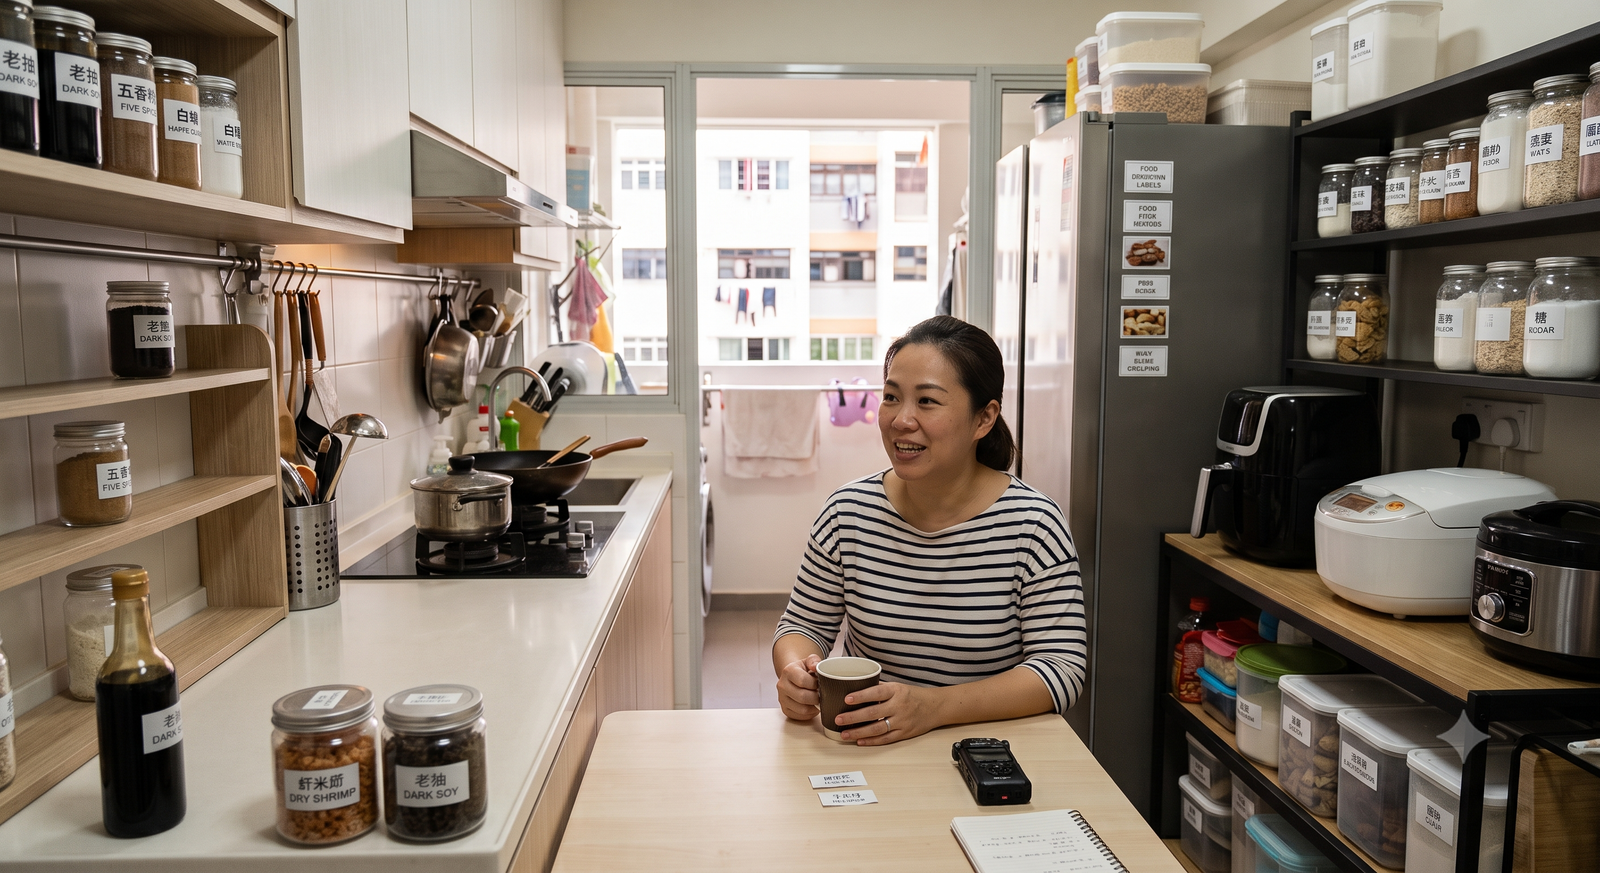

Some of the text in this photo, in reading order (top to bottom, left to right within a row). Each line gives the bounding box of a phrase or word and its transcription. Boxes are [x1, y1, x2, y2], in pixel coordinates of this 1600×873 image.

[2, 50, 36, 75] 老抽
[69, 63, 98, 86] 老抽
[62, 84, 89, 96] DARK
[120, 102, 140, 113] FIVE
[1136, 181, 1162, 189] LABELS
[1534, 311, 1547, 324] 糖
[140, 335, 163, 343] DARK
[102, 482, 121, 492] FIVE
[152, 728, 177, 745] DARK
[289, 787, 357, 804] DRY SHRIMP
[403, 786, 459, 800] DARK SOY
